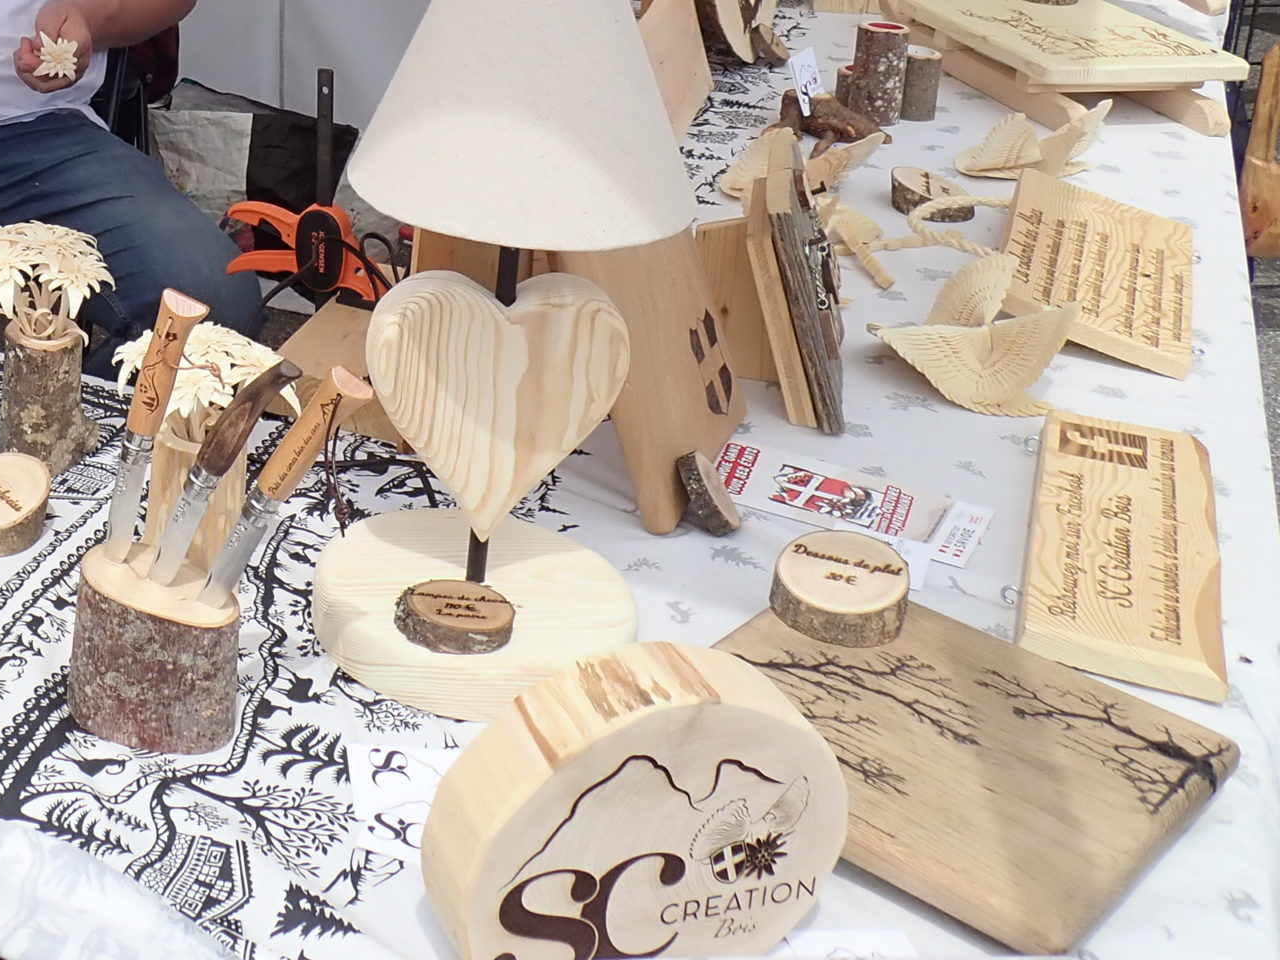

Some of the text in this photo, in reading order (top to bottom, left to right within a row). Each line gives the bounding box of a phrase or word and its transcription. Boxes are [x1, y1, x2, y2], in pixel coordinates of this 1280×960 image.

[1015, 208, 1049, 230] Alpes
[1017, 227, 1039, 242] des
[1008, 238, 1036, 271] colombe
[791, 543, 903, 576] Dessous de plat
[1047, 470, 1087, 621] Retrouvez moi sur Facebook
[1096, 494, 1133, 609] SC Création Bois
[845, 576, 858, 586] €
[456, 594, 472, 602] de
[1149, 604, 1182, 646] Fabrication
[494, 852, 817, 960] SC CREATION
[713, 915, 759, 940] Bois
